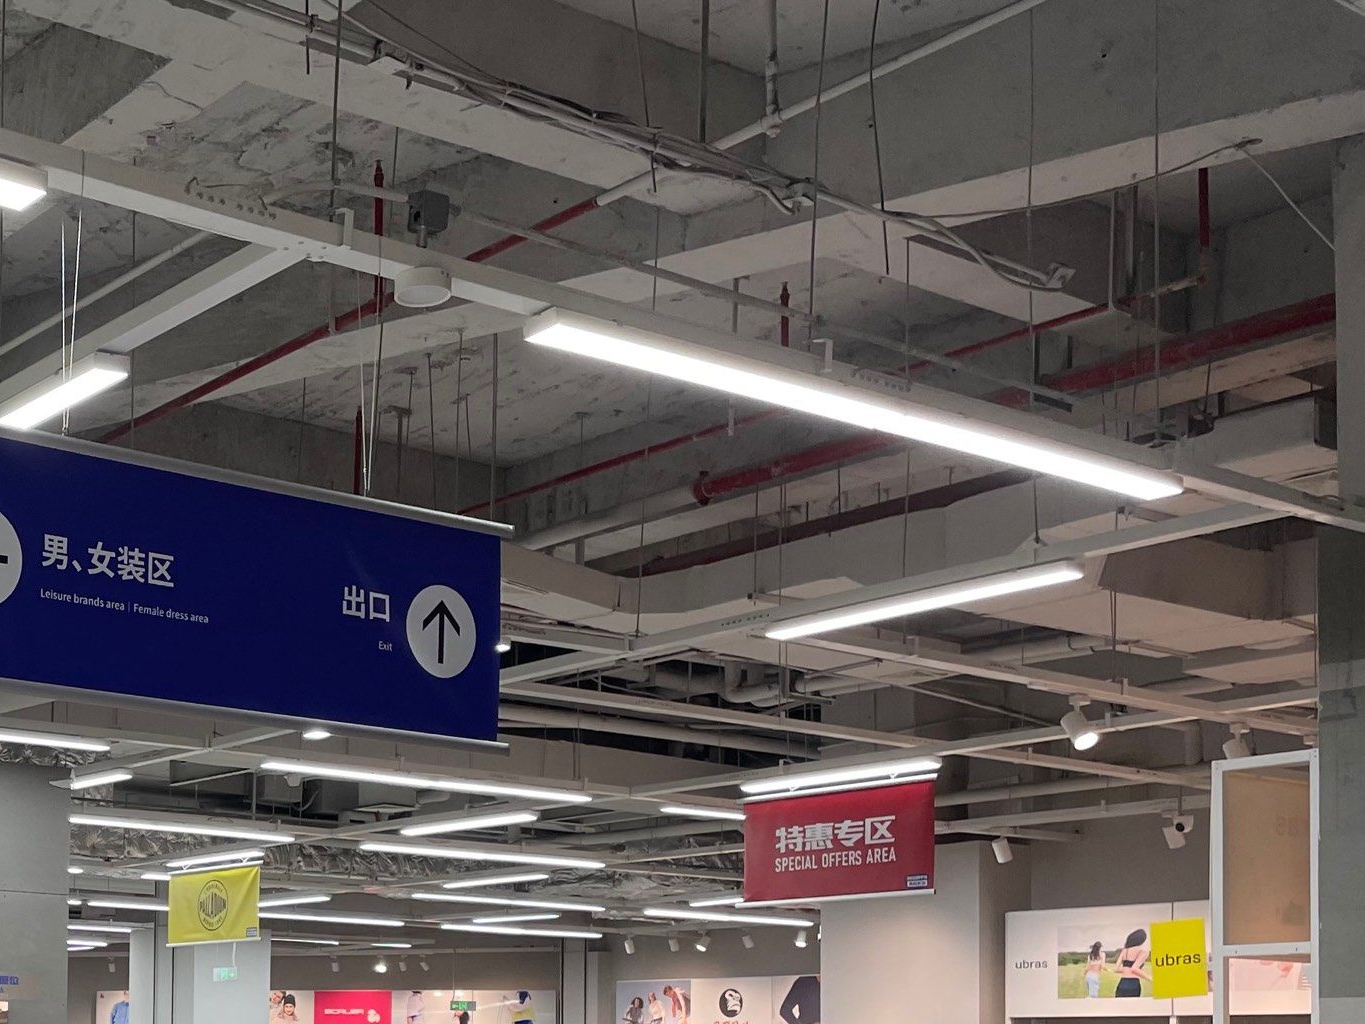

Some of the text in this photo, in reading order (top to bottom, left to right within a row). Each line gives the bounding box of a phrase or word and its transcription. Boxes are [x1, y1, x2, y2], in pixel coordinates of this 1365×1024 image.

[42, 533, 174, 588] 男、女装区
[40, 588, 209, 624] Leisure brands area Female dress area
[342, 585, 390, 622] 出口
[378, 641, 393, 652] Exit
[775, 815, 896, 853] 特惠专区
[775, 846, 897, 873] SPECIAL OFFERS AREA
[1015, 958, 1048, 969] ubras
[1155, 951, 1201, 967] ubras
